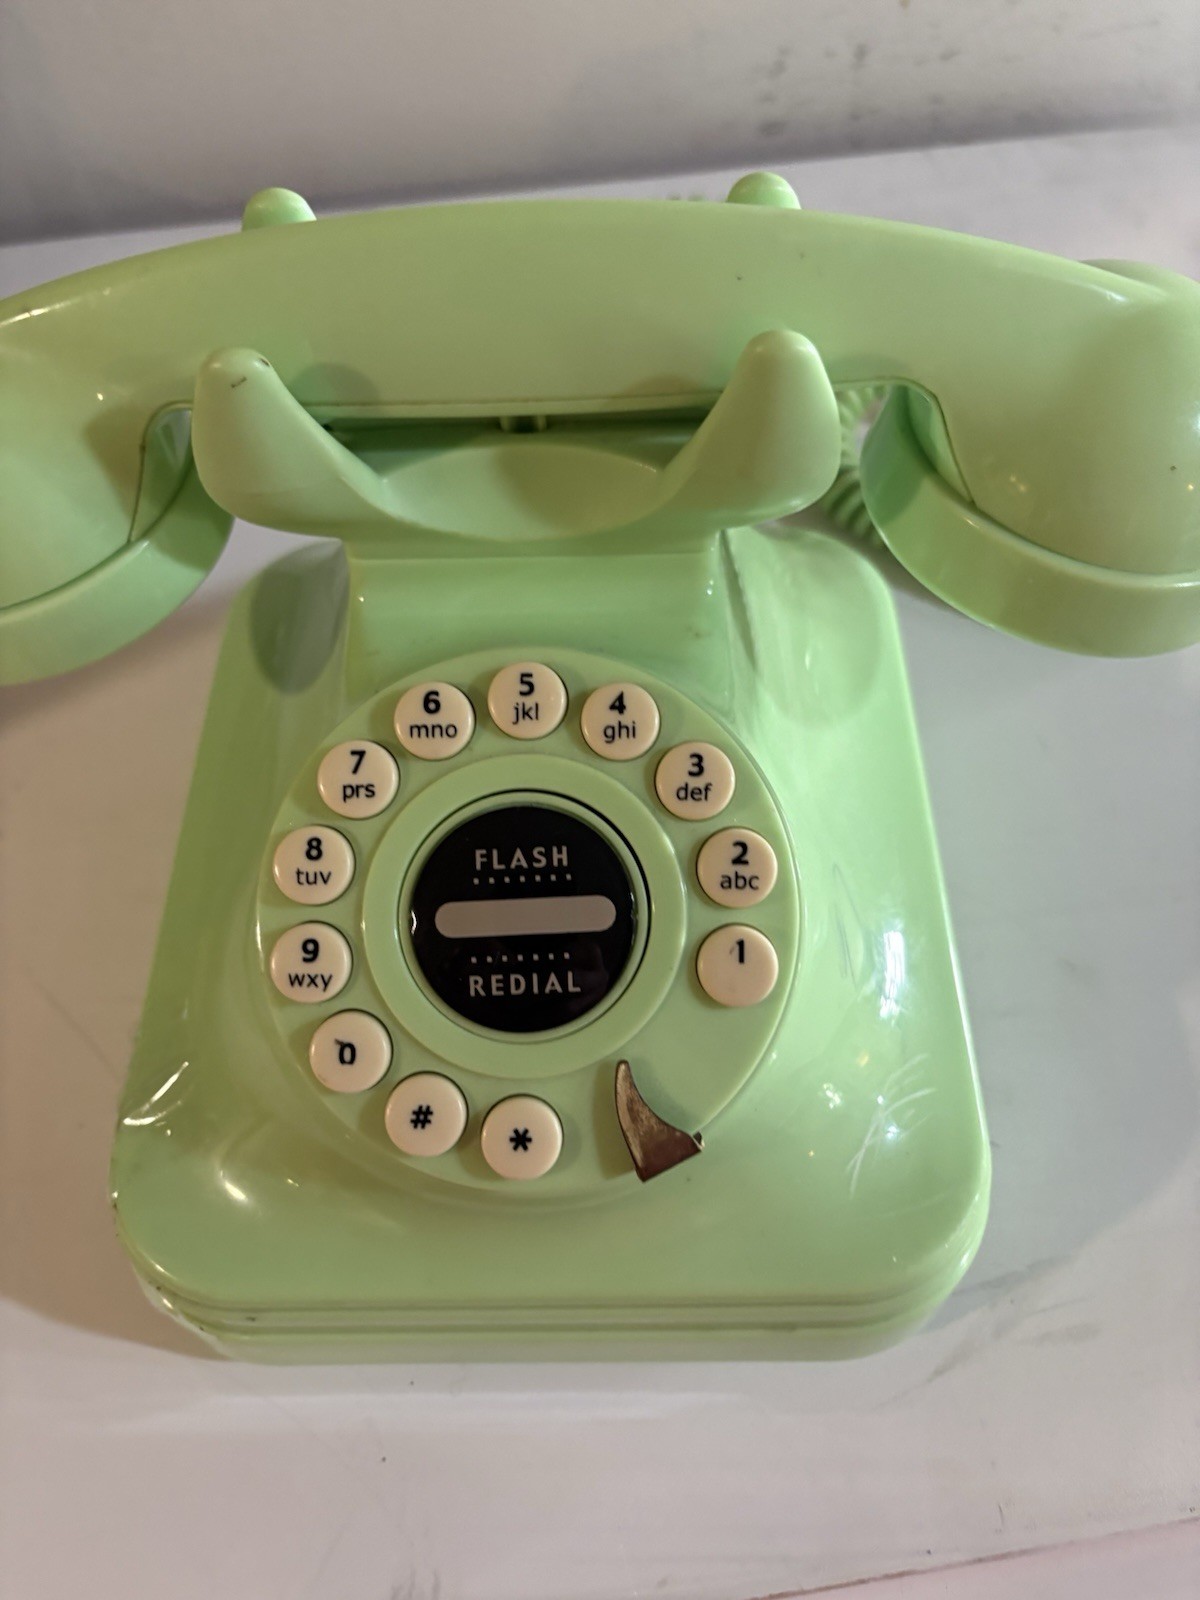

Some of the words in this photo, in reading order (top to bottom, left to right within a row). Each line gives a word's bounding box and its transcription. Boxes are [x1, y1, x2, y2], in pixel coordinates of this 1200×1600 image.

[518, 671, 536, 698] 5
[421, 689, 442, 716] 6
[511, 700, 540, 726] jkl
[607, 690, 628, 717] 4
[408, 722, 459, 740] mno
[602, 719, 637, 745] ghi
[349, 748, 367, 776] 7
[686, 751, 706, 778] 3
[341, 782, 377, 804] prs
[674, 780, 714, 803] def
[304, 835, 324, 862] 8
[475, 845, 569, 870] FLASH
[729, 839, 751, 867] 2
[294, 867, 332, 887] tuv
[718, 869, 760, 893] abc
[300, 937, 321, 965] 9
[728, 937, 746, 965] 1
[287, 972, 334, 993] wxy
[469, 971, 582, 997] REDIAL
[337, 1040, 357, 1066] 0
[408, 1103, 435, 1131] #
